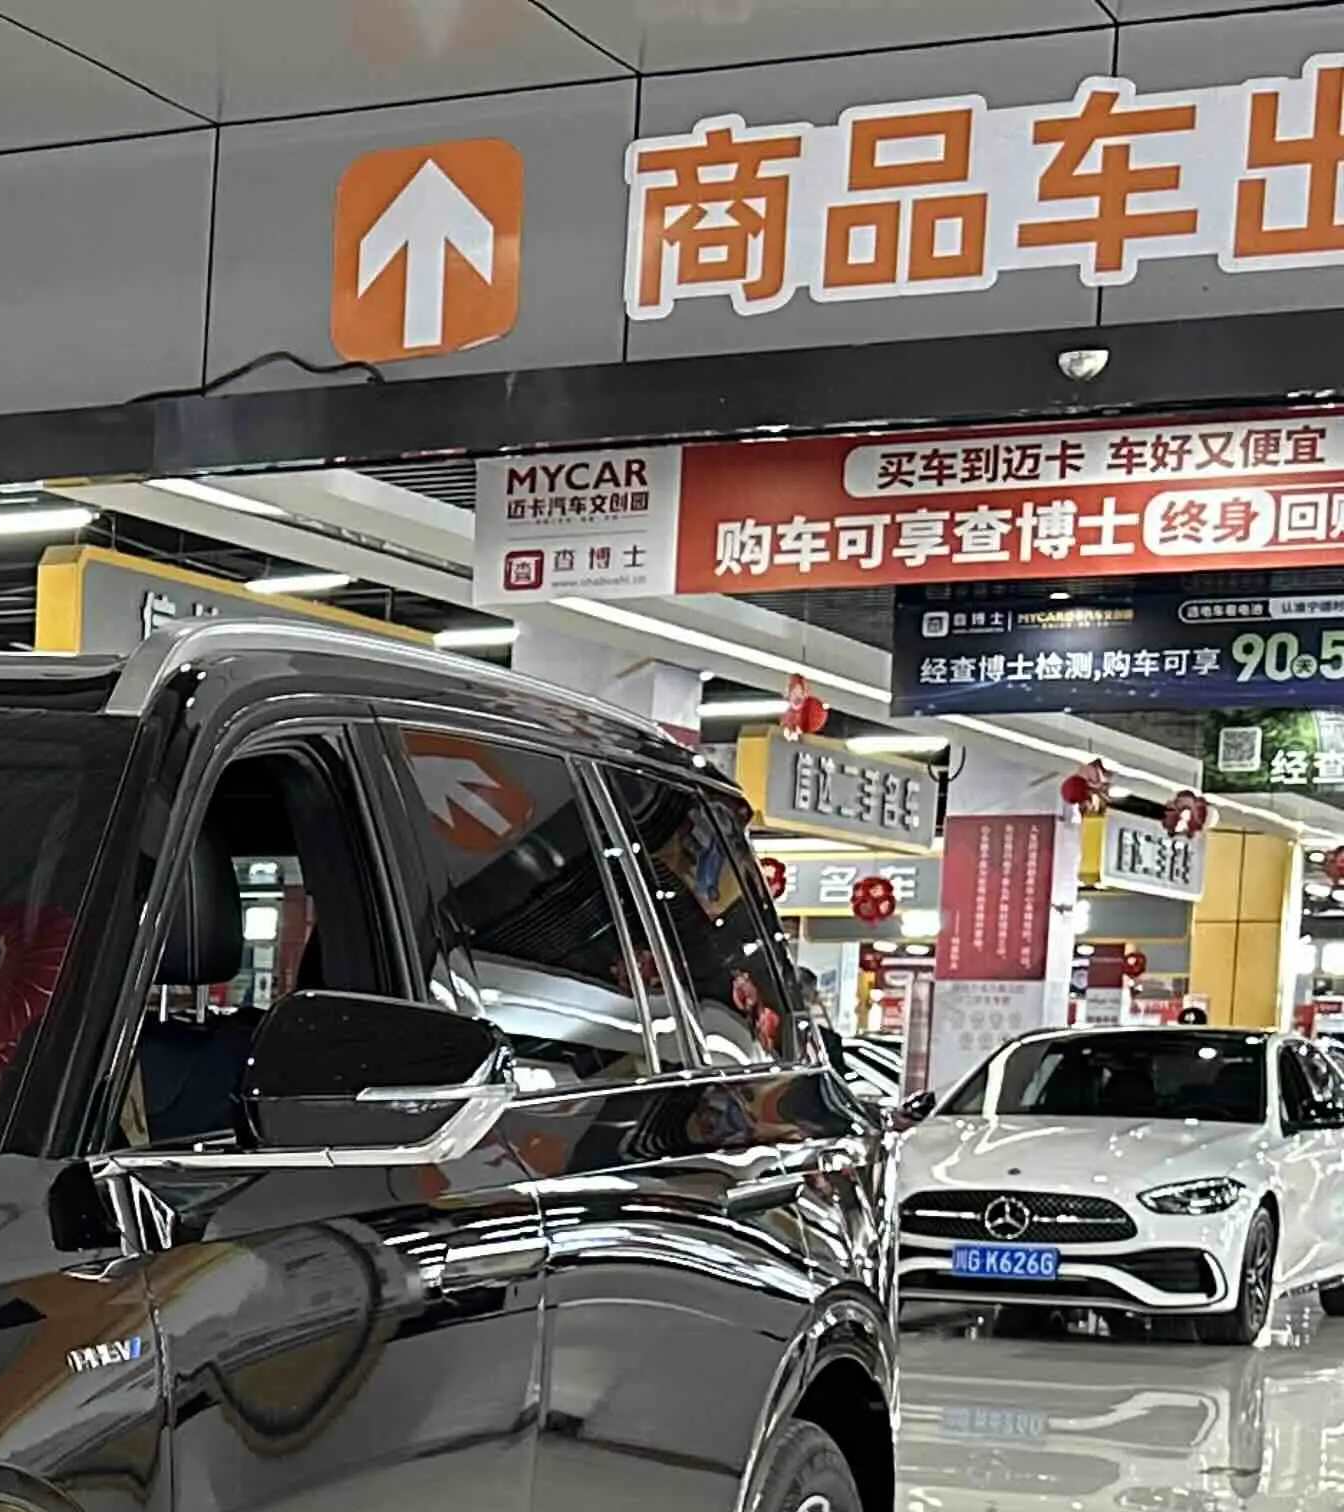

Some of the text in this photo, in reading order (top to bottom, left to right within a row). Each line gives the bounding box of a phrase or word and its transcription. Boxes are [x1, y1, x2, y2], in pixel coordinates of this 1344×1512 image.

[628, 60, 1344, 318] 商品车出
[878, 425, 1326, 489] 买车到迈卡 车好又便宜
[506, 458, 648, 495] MYCAR
[506, 491, 649, 519] 迈卡汽车文创园
[715, 492, 1344, 577] 购车可享查博士终身回
[553, 544, 645, 572] 查博士
[920, 649, 1220, 684] 经查博士检测,购车可享
